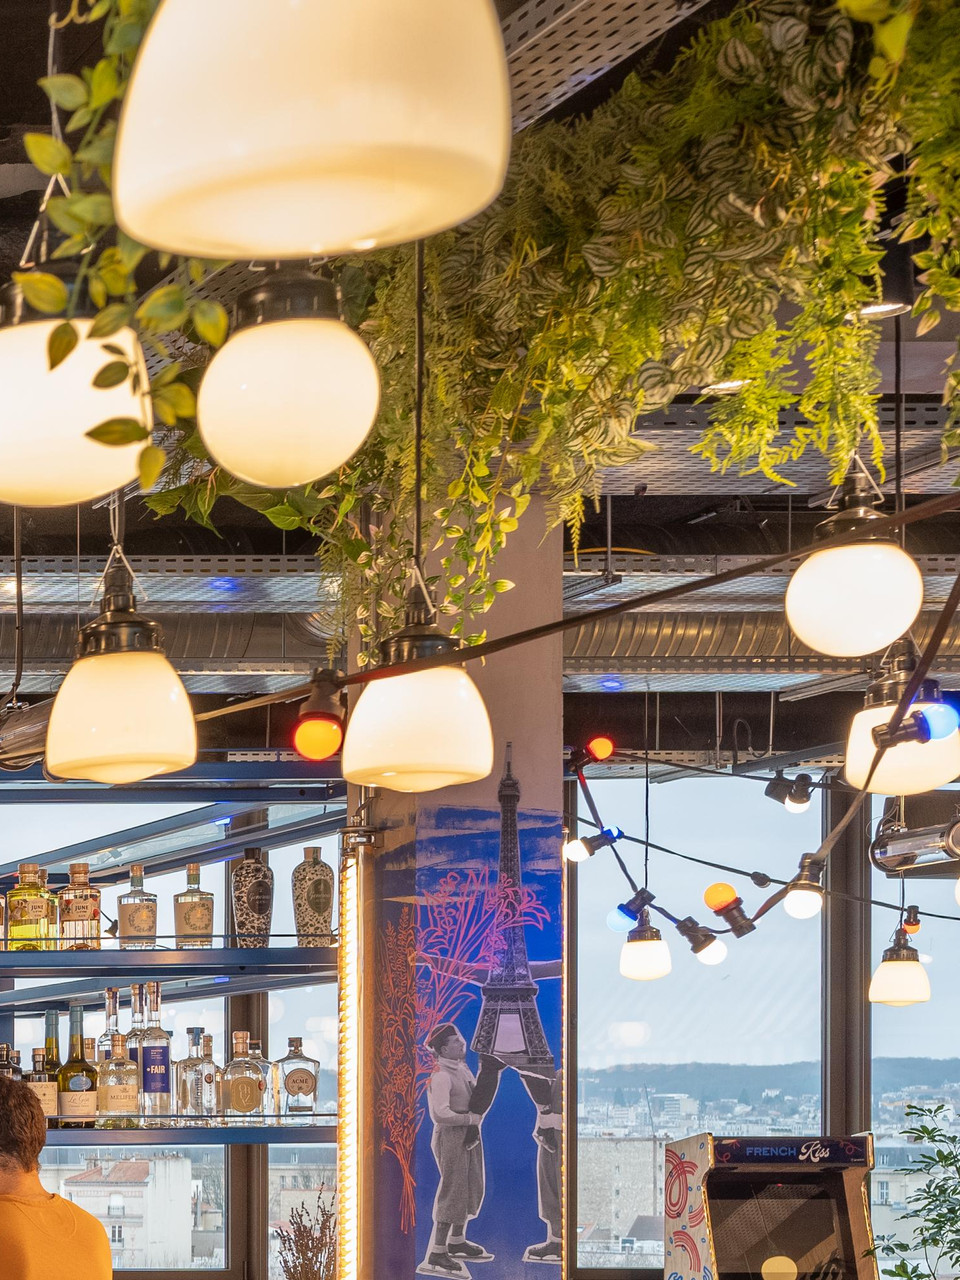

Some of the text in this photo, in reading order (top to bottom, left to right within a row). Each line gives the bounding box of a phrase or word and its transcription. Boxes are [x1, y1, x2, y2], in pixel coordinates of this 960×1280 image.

[150, 1065, 166, 1074] FAIR
[745, 1140, 830, 1163] FRENCH Kiss
